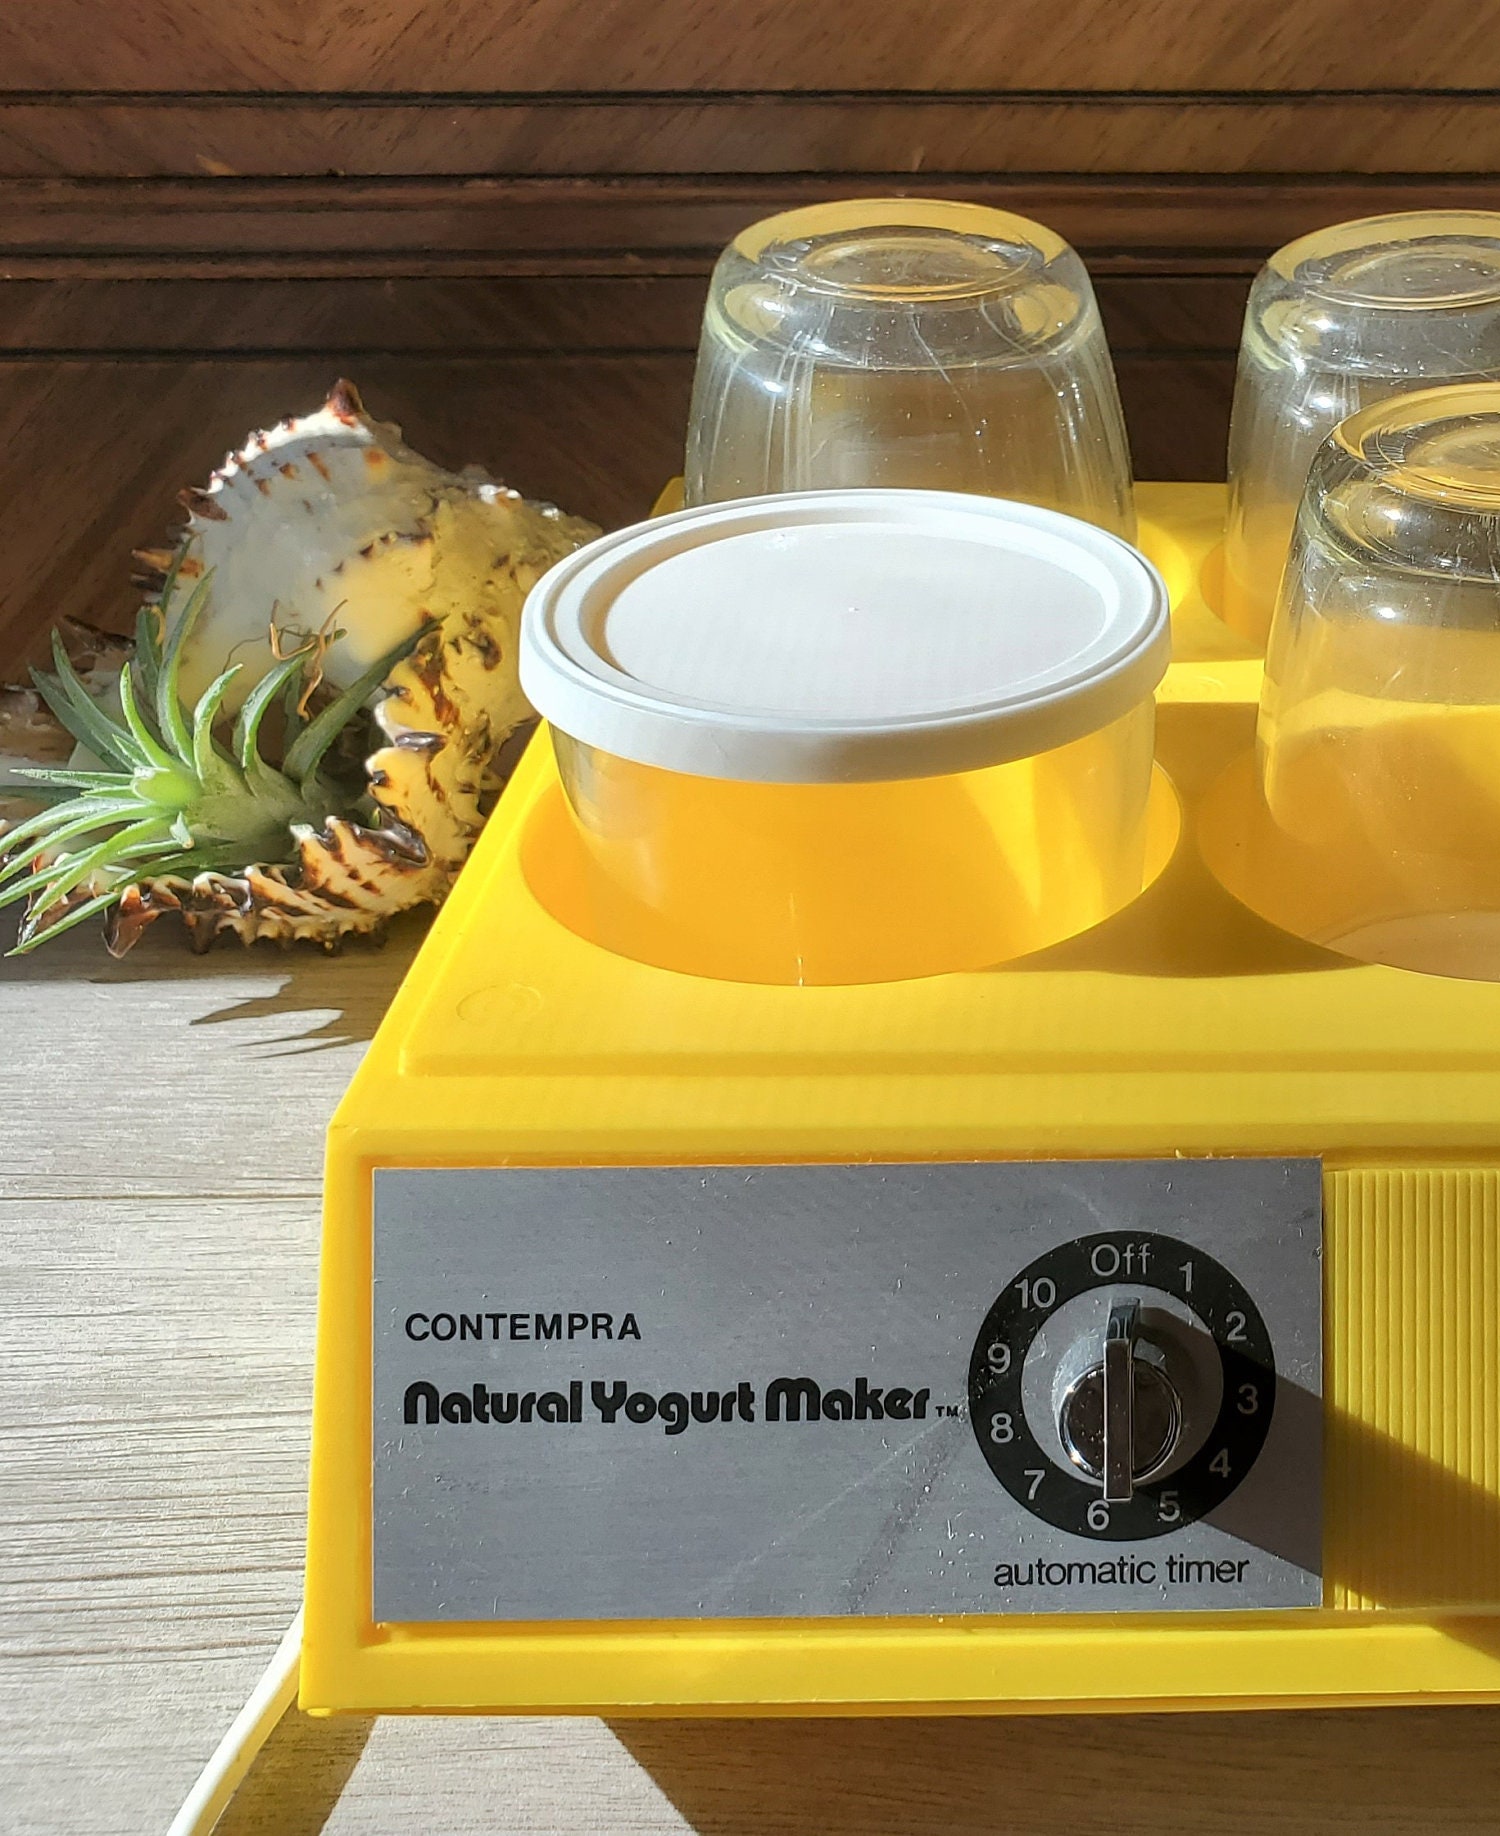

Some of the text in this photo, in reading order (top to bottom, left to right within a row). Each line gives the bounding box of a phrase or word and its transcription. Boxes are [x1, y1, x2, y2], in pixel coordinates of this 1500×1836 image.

[1090, 1243, 1151, 1277] Off
[1179, 1260, 1195, 1293] 1
[1015, 1277, 1057, 1310] 10
[404, 1313, 642, 1341] CONTEMPRA
[1225, 1312, 1247, 1342] 2
[987, 1342, 1011, 1374] 9
[403, 1380, 583, 1424] Natural
[591, 1381, 756, 1434] Yogurt
[765, 1377, 930, 1421] Maker
[1236, 1385, 1259, 1416] 3
[990, 1412, 1014, 1444] 8
[1210, 1448, 1232, 1479] 4
[1023, 1470, 1046, 1501] 7
[1086, 1500, 1110, 1532] 6
[1158, 1491, 1181, 1523] 5
[993, 1554, 1251, 1587] automatic timer
